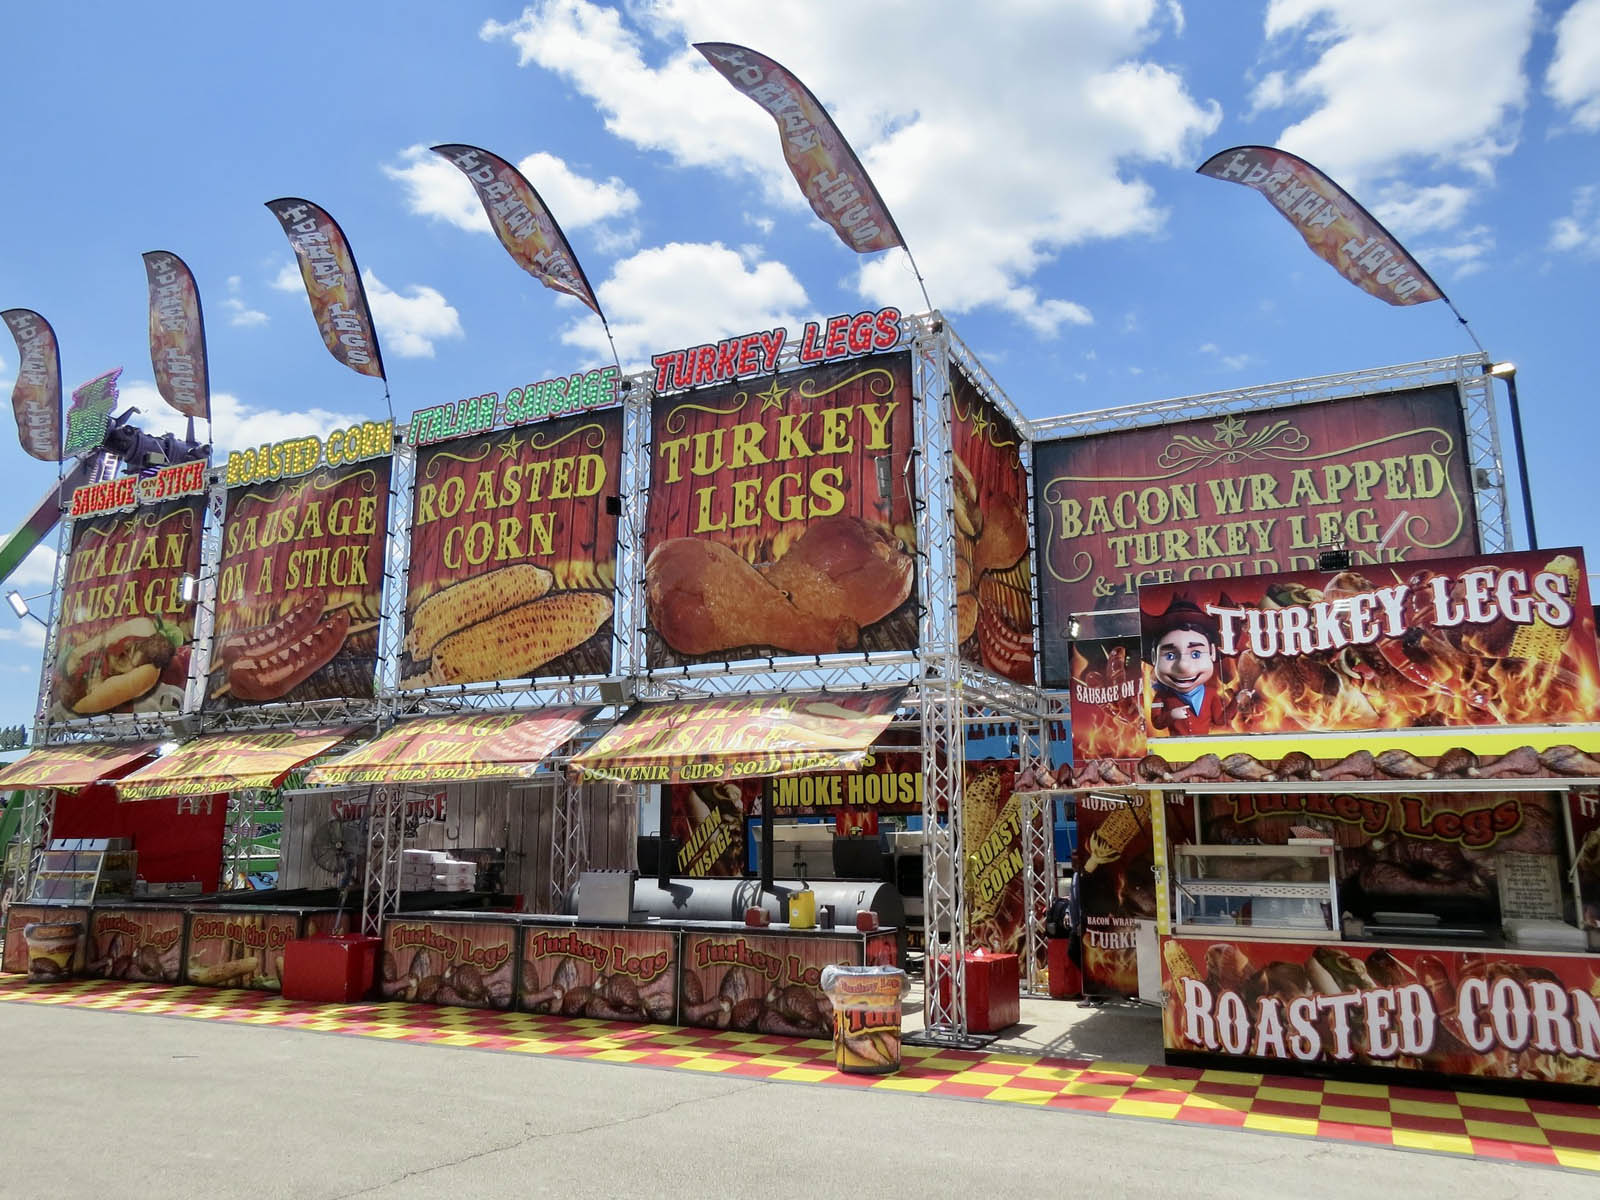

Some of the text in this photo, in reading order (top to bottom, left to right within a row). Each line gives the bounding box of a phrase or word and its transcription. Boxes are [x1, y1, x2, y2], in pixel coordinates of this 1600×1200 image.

[652, 307, 902, 393] TURKEY LEGS
[408, 366, 620, 446] ITALIAN SAUSAGE
[226, 421, 393, 486] ROASTED CORN
[659, 401, 900, 484] TURKEY
[71, 476, 137, 516] SAUSAGE
[155, 460, 205, 498] STICK
[416, 454, 607, 526] ROASTED
[694, 466, 846, 533] LEGS
[1059, 453, 1446, 540] BACON WRAPPED
[225, 496, 377, 559] SAUSAGE
[443, 512, 557, 570] CORN
[1108, 507, 1381, 568] TURKEY LEG
[70, 533, 189, 584] ITALIAN
[221, 545, 370, 605] ON A STICK
[62, 576, 187, 628] SAUSAGE
[1092, 575, 1116, 597] &
[1205, 568, 1574, 659] TURKEY LEGS
[622, 696, 801, 732] ITALIAN
[1076, 684, 1119, 704] SAUSAGE
[1121, 680, 1135, 698] ON
[586, 722, 794, 758] SAUSAGE
[319, 769, 386, 783] SOUVENIR
[392, 769, 427, 781] CUPS
[431, 767, 474, 780] SOLD
[583, 765, 670, 782] SOUVENIR
[680, 762, 725, 780] CUPS
[731, 759, 781, 776] SOLD
[1400, 796, 1521, 847] Legs
[980, 847, 1025, 902] CORN
[145, 924, 183, 951] Legs
[192, 917, 226, 940] Corn
[227, 922, 243, 943] on
[244, 922, 268, 949] the
[392, 923, 510, 971] Turkey Legs
[1086, 928, 1136, 950] TURKE
[1087, 916, 1136, 927] BACON WRAP
[532, 929, 669, 981] Turkey Legs
[694, 937, 826, 989] Turkey Le
[1181, 974, 1438, 1064] ROASTED
